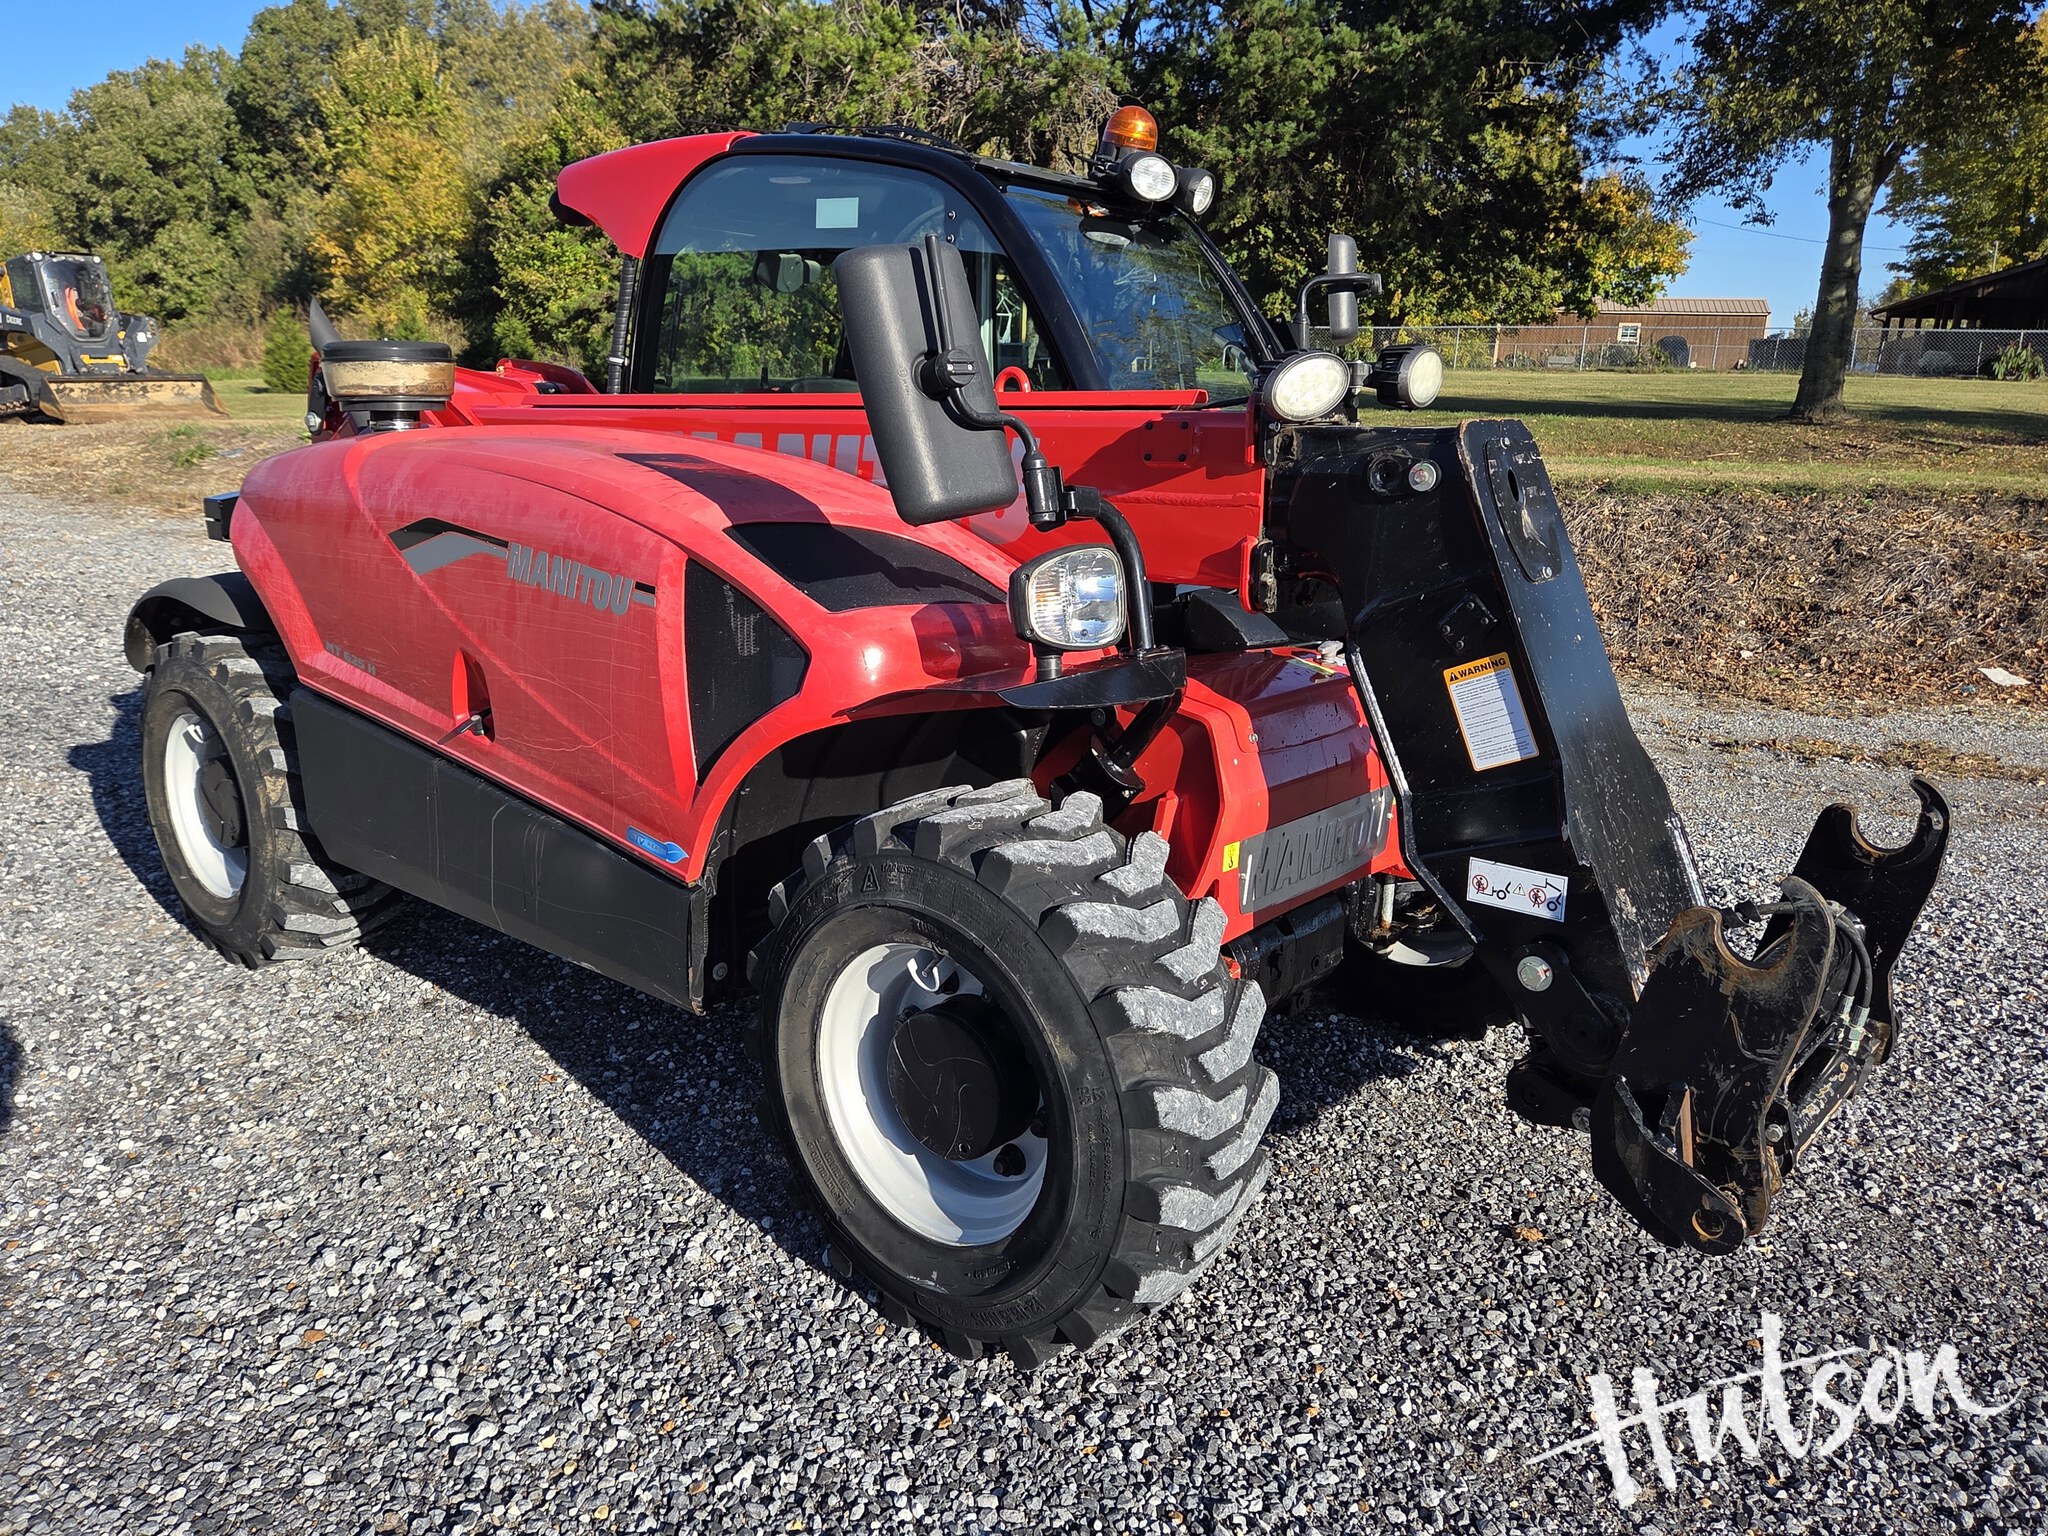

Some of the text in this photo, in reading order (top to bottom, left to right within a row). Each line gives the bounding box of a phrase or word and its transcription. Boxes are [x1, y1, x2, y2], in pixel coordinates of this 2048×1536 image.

[507, 542, 634, 615] MANITOU
[343, 651, 365, 670] 625
[367, 662, 376, 676] H
[1457, 658, 1506, 678] WARNING
[1251, 788, 1386, 902] MANITOU
